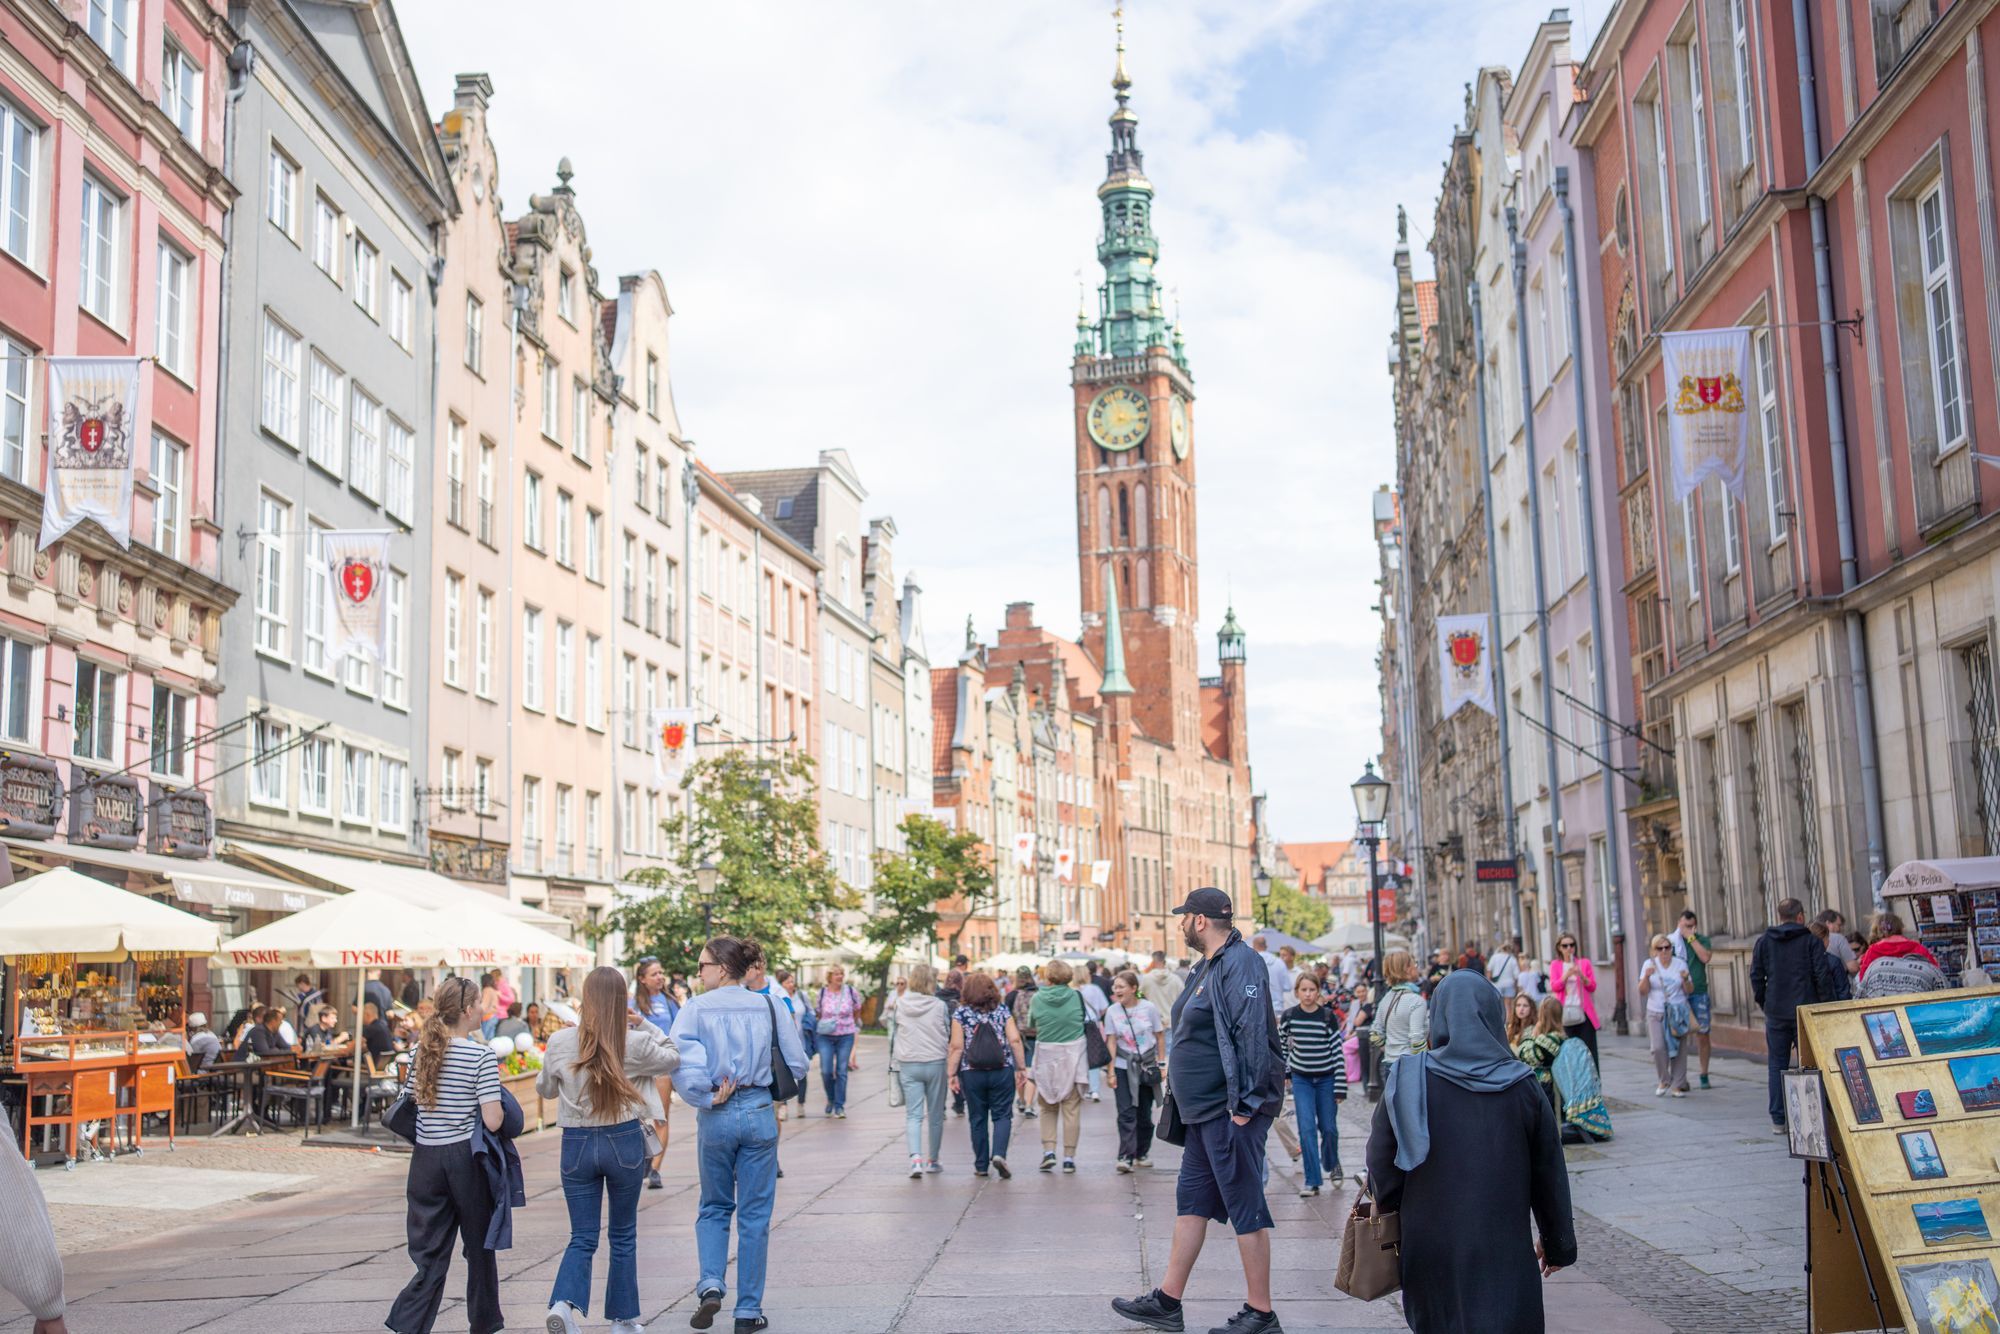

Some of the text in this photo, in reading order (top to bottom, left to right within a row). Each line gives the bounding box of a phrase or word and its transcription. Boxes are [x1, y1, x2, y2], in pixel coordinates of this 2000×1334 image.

[7, 783, 50, 806] PIZZERIA
[97, 797, 135, 822] NAPOLI
[1477, 867, 1516, 879] WECHSEL
[1887, 874, 1942, 889] Poczta Polska
[230, 950, 283, 965] TYSKIE
[339, 950, 404, 965] TYSKIE
[459, 948, 496, 963] TYSKIE
